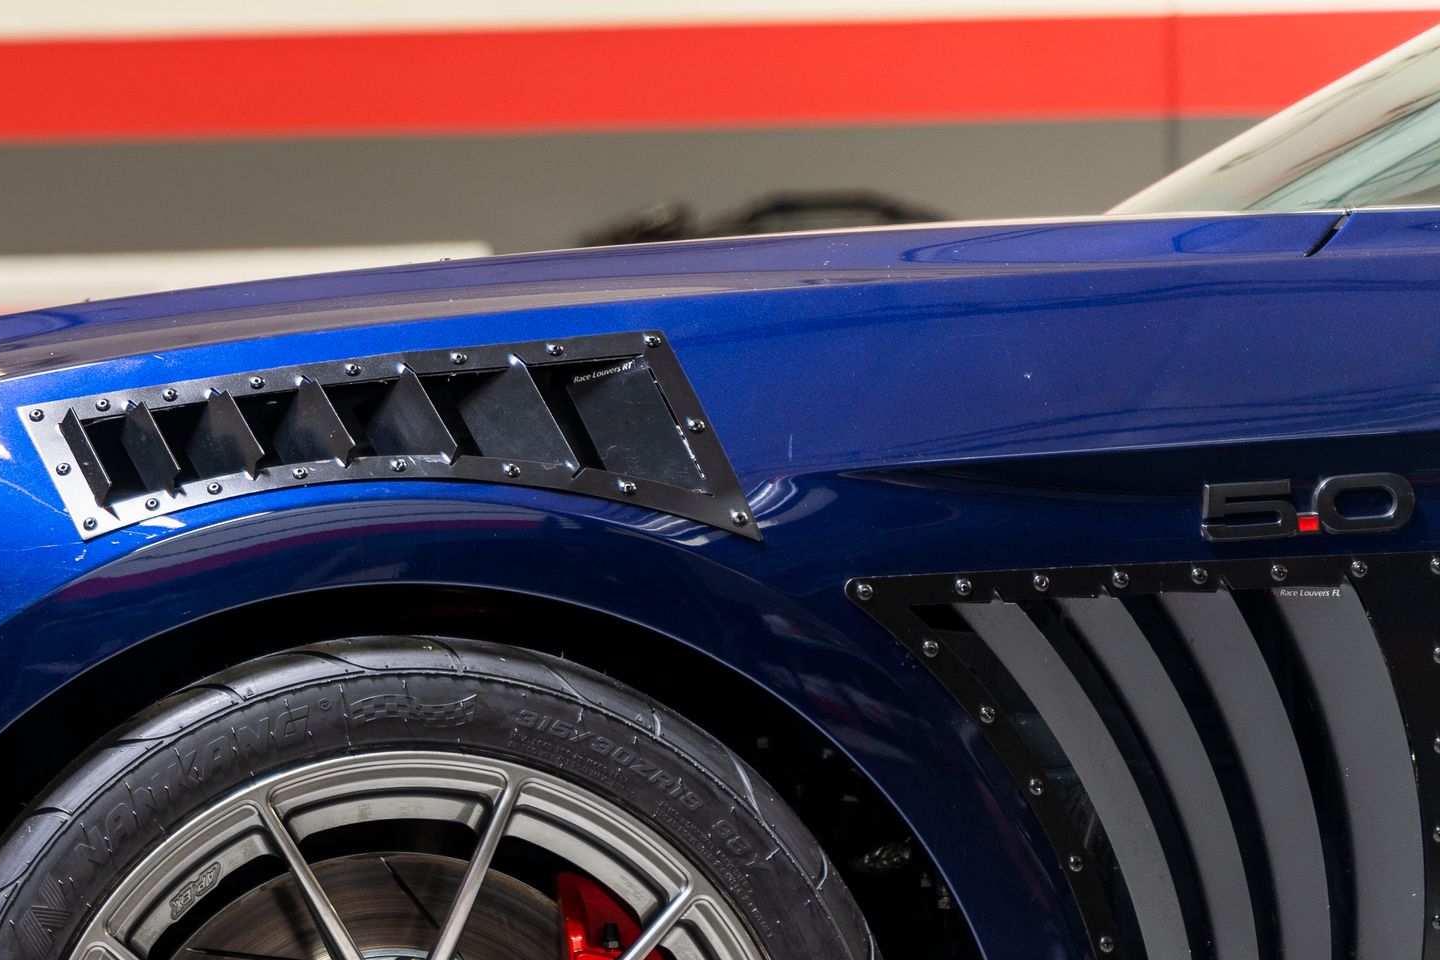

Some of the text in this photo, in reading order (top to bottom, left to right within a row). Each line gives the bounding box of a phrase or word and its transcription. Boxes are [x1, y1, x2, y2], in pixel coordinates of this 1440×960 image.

[573, 361, 633, 384] Race Louvers RT
[1201, 472, 1415, 542] 5.0
[1280, 589, 1341, 597] Race Louvers FL
[511, 706, 706, 814] 315/30ZR18
[72, 703, 309, 881] NANKANG
[171, 864, 220, 916] APEX
